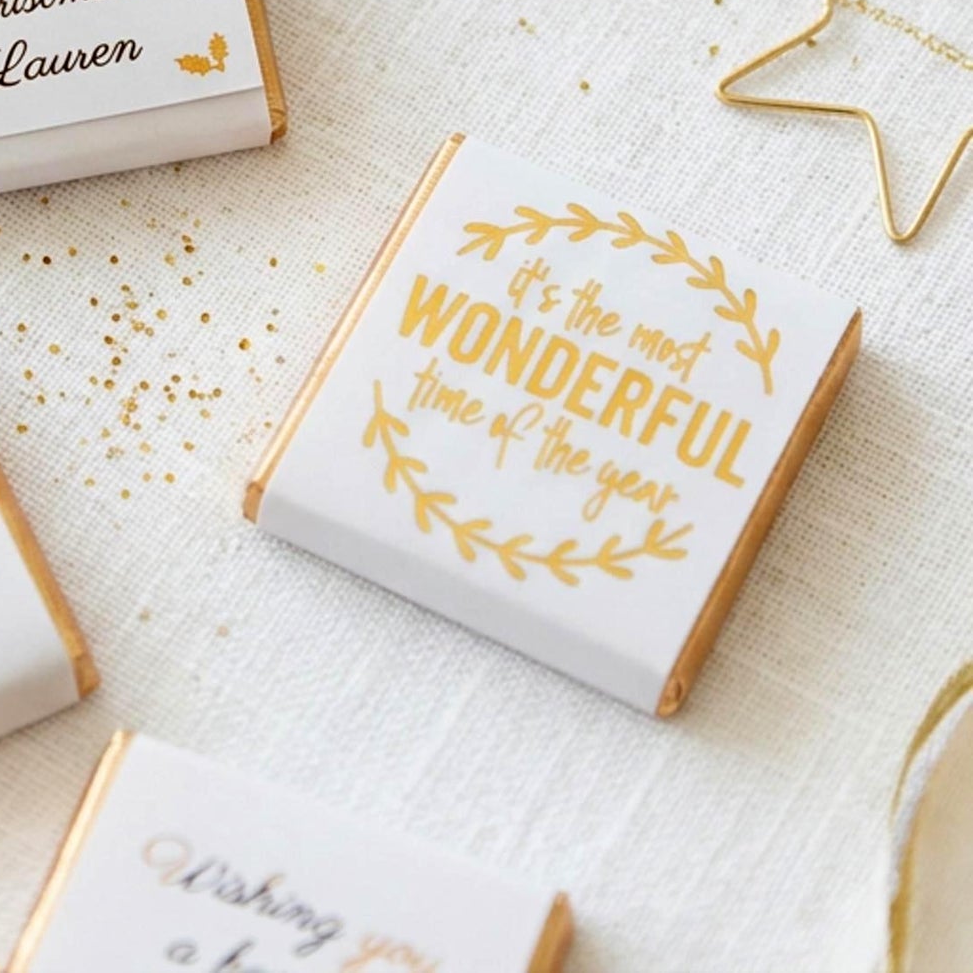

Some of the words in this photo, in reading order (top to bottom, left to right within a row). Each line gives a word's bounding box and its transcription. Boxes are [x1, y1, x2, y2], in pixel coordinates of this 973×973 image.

[397, 273, 752, 489] WONDERFUL
[507, 258, 561, 313] it's
[565, 279, 621, 335] the
[628, 323, 712, 383] most
[408, 358, 486, 426] time
[488, 403, 544, 469] of
[533, 417, 592, 472] the
[582, 459, 680, 522] year
[142, 834, 348, 959] Wishing
